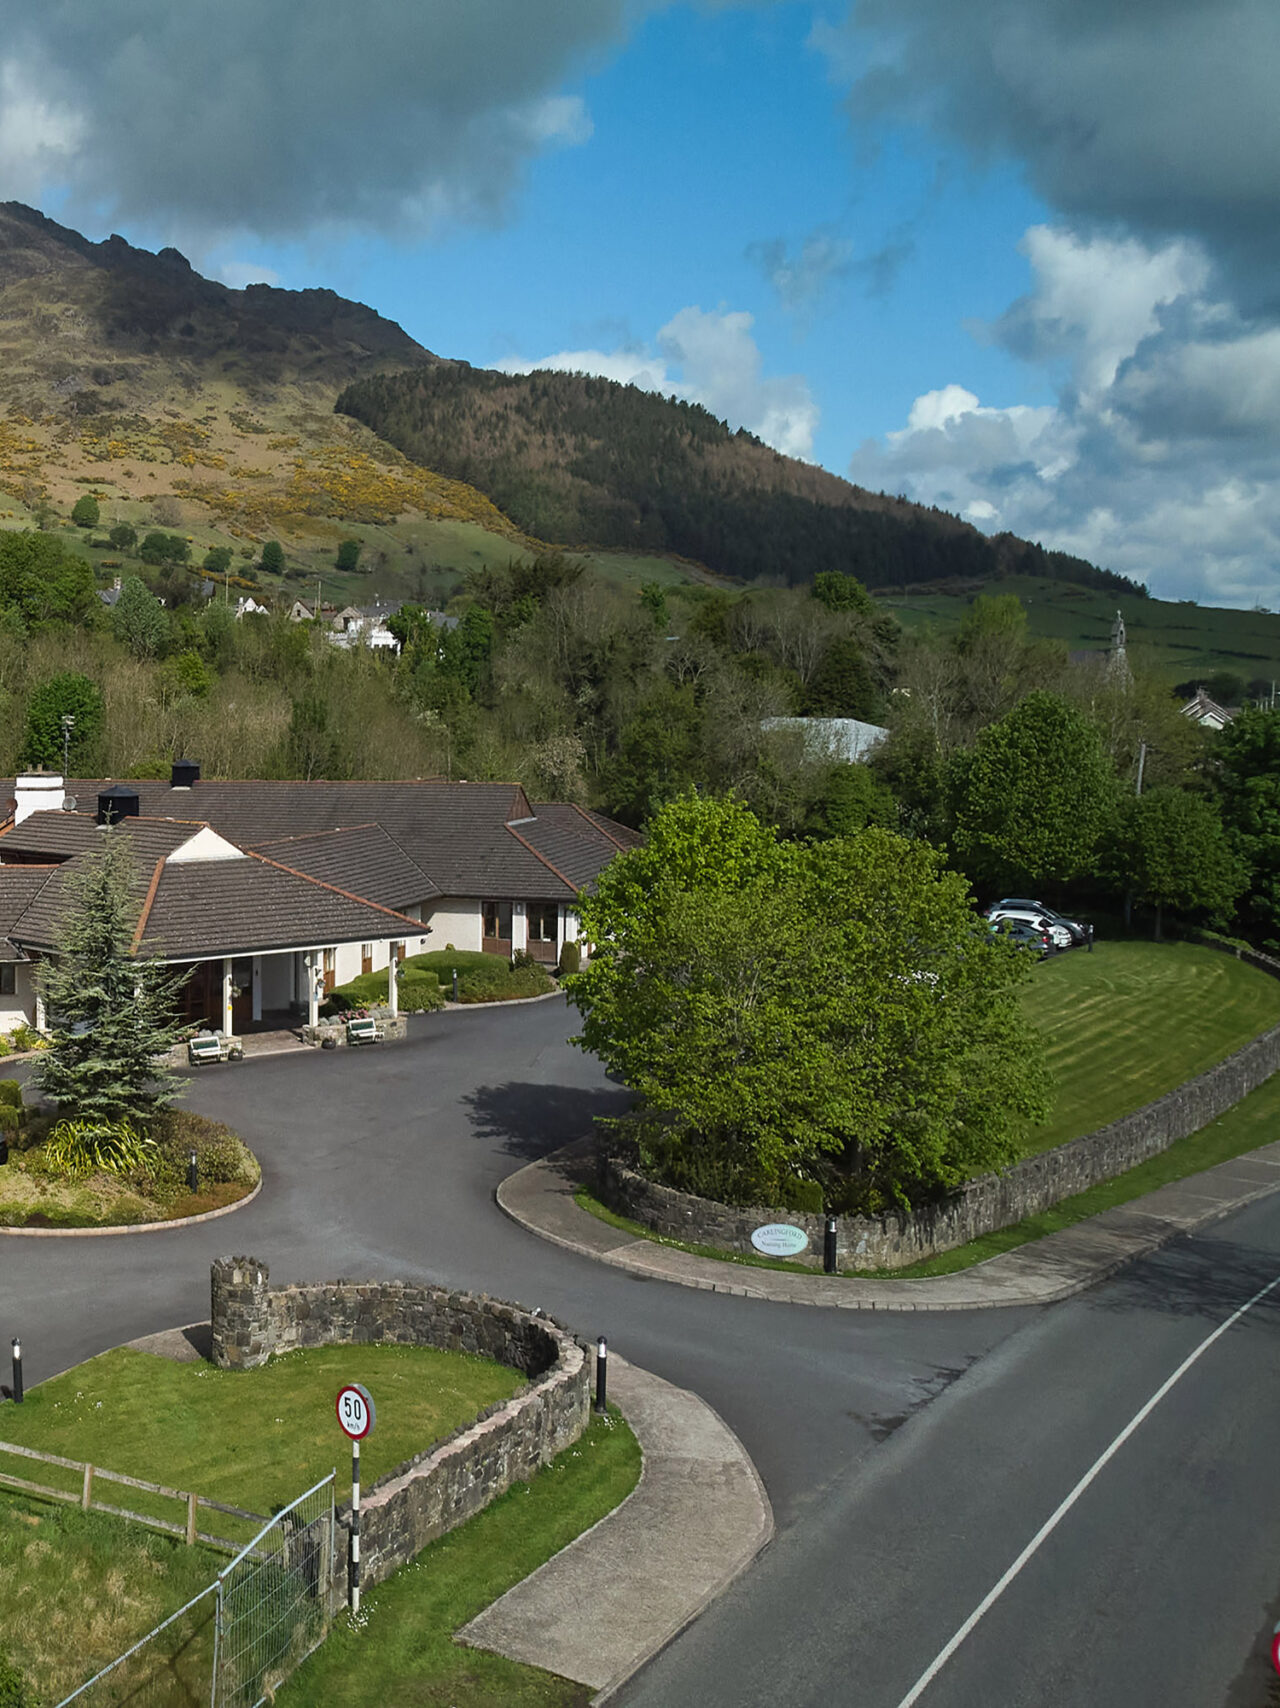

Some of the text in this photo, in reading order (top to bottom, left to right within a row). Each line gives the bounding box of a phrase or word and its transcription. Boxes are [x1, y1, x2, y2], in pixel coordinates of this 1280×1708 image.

[757, 1229, 802, 1240] CARLINGFORD
[344, 1396, 361, 1420] 50
[347, 1421, 360, 1431] km/h
